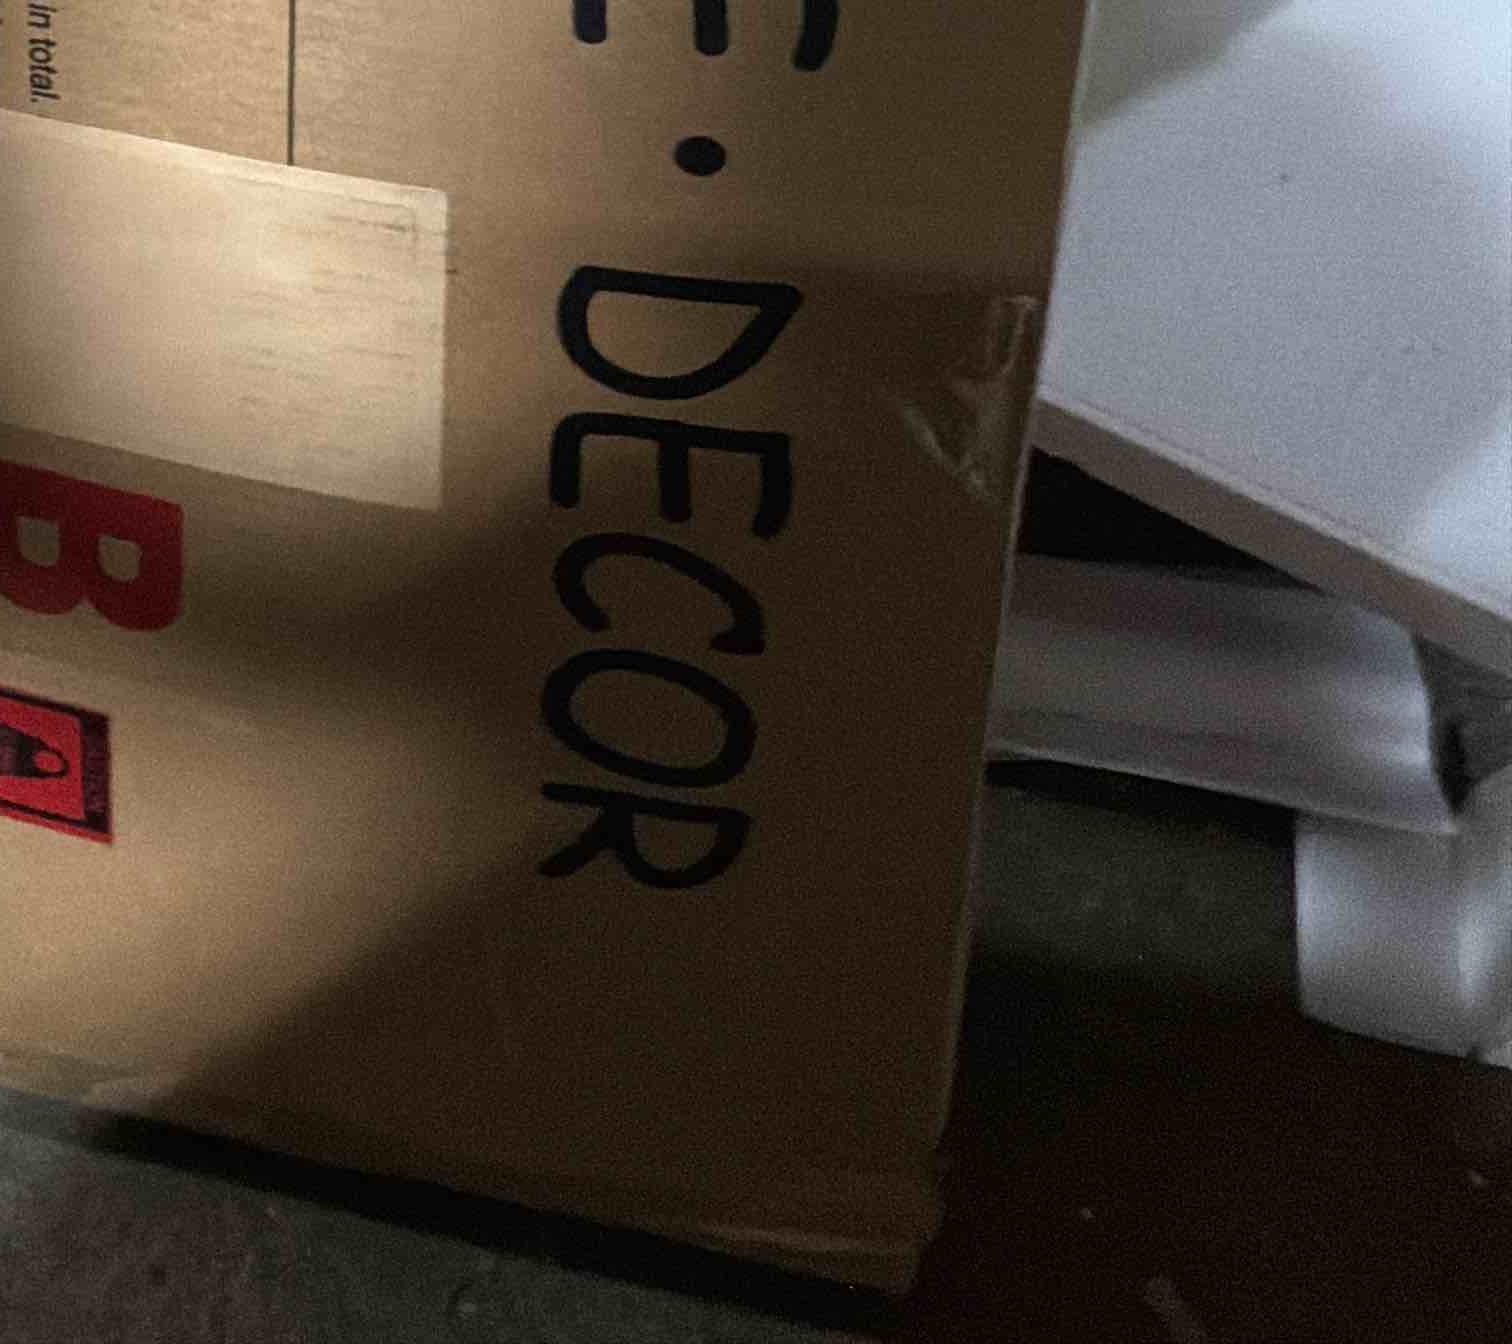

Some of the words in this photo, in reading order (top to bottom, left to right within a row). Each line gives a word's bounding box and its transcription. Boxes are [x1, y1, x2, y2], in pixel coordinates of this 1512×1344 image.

[31, 2, 54, 29] in
[27, 34, 61, 103] total.
[538, 263, 803, 892] DECOR
